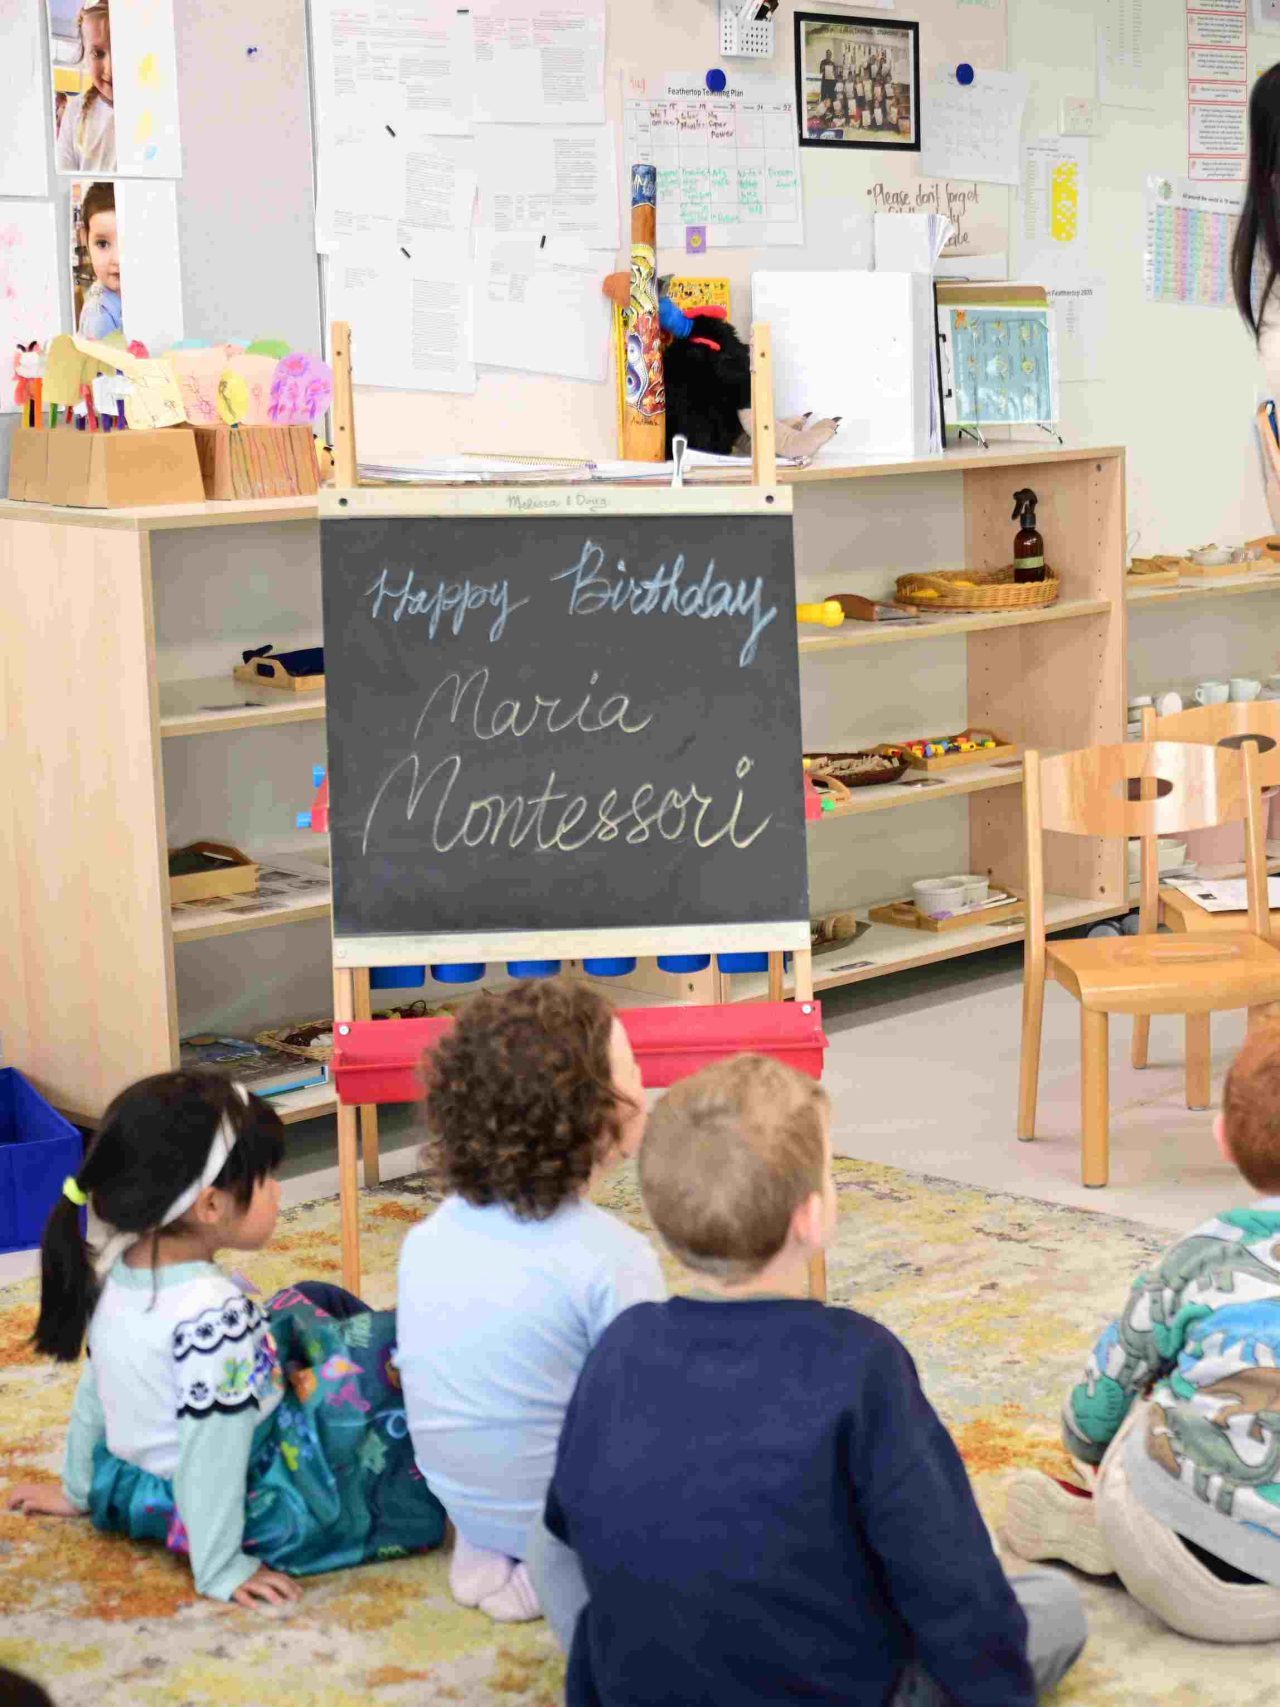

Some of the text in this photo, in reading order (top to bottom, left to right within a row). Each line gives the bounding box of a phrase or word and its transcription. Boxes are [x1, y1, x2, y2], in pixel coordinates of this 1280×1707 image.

[668, 87, 701, 98] Feathertop
[731, 89, 744, 98] Plan
[873, 182, 980, 217] Please don't forget
[364, 538, 777, 667] Happy Birthday
[414, 667, 652, 740] Maria
[362, 754, 773, 856] Montessori
